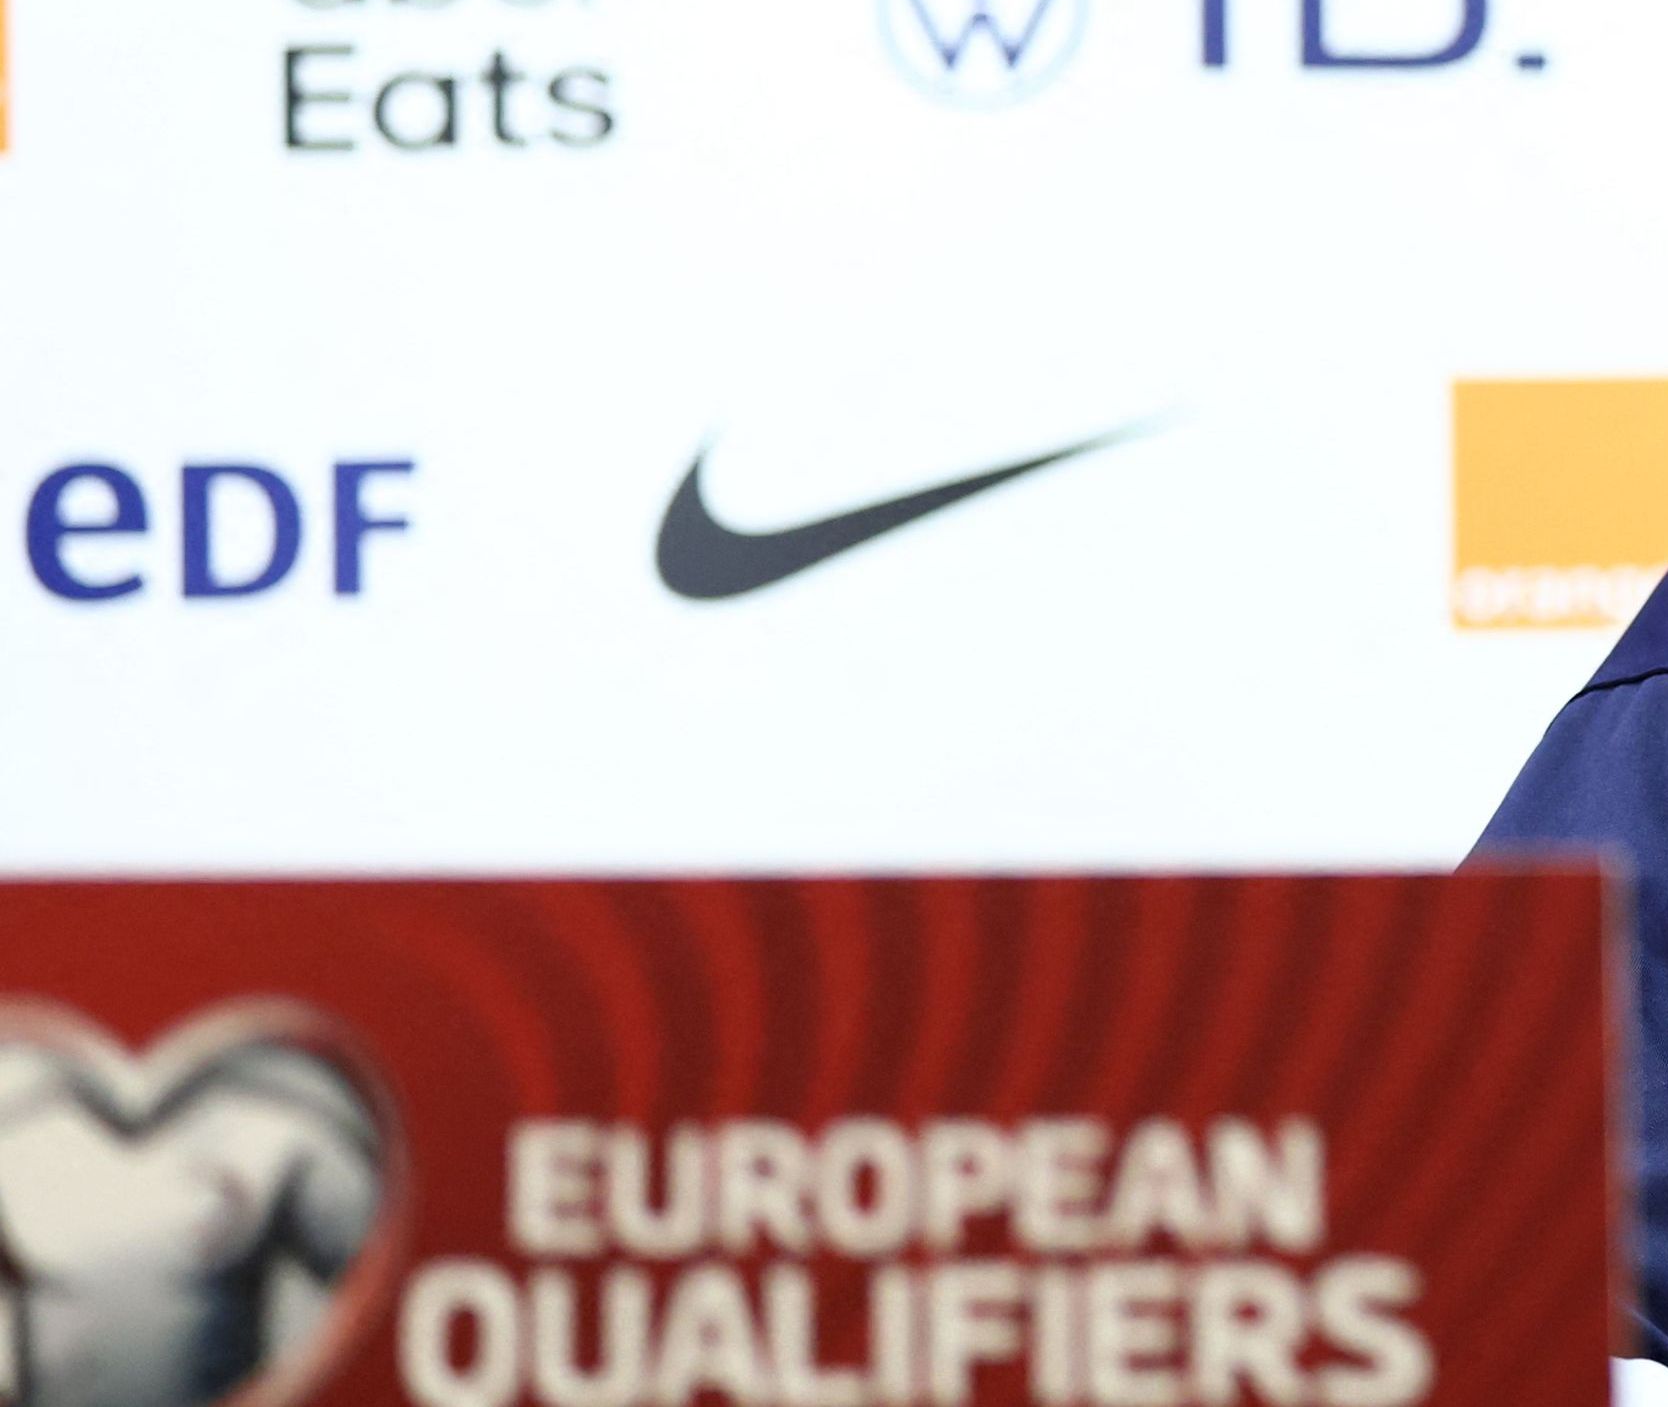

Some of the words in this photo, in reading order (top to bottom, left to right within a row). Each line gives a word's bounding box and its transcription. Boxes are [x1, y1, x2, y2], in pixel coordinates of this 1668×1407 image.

[280, 44, 616, 153] Eats
[508, 1116, 1328, 1256] EUROPEAN
[400, 1252, 1434, 1407] QUALIFIERS
